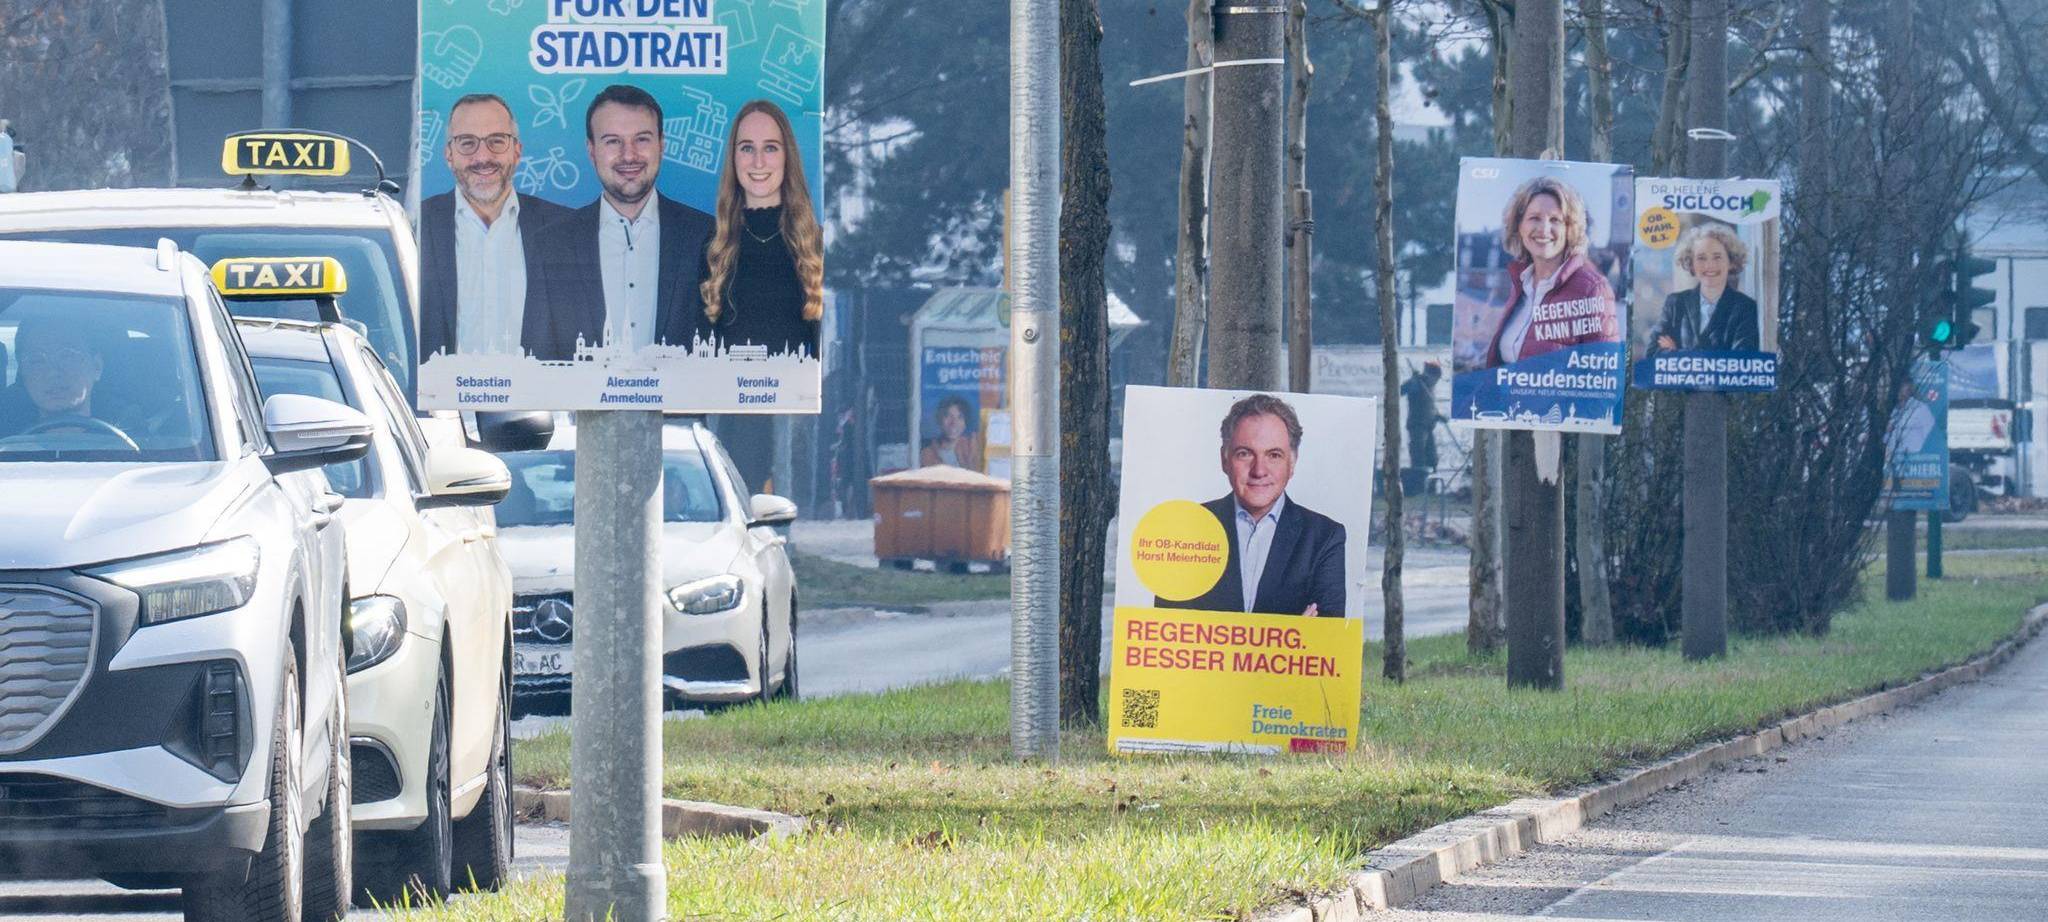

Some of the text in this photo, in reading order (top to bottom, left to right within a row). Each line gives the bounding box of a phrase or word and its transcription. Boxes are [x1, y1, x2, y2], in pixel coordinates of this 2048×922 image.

[536, 31, 722, 68] STADTRAT!
[246, 141, 326, 167] TAXI
[1471, 167, 1501, 179] CSU
[1673, 185, 1720, 195] HELENE
[1662, 194, 1755, 211] SIGLOCH
[1642, 222, 1674, 234] WAHL
[230, 263, 321, 289] TAXI
[1533, 296, 1605, 323] REGENSBURG
[1534, 316, 1603, 342] KANN MEHR
[1566, 350, 1619, 370] Astrid
[1654, 357, 1776, 374] REGENSBURG
[455, 376, 512, 388] Sebastian
[606, 376, 660, 388] Alexander
[736, 376, 780, 388] Veronika
[1496, 367, 1618, 391] Freudenstein
[1654, 373, 1776, 387] EINFACH MACHEN
[458, 392, 510, 404] Löschner
[600, 392, 664, 405] Ammelounx
[738, 393, 777, 404] Brandel
[1138, 537, 1221, 552] Ihr OB-Kandidat
[1137, 550, 1164, 562] Horst
[1126, 620, 1307, 650] REGENSBURG.
[1125, 646, 1342, 678] BESSER MACHEN.
[1252, 703, 1293, 719] Freie
[1251, 720, 1348, 738] Demokraten
